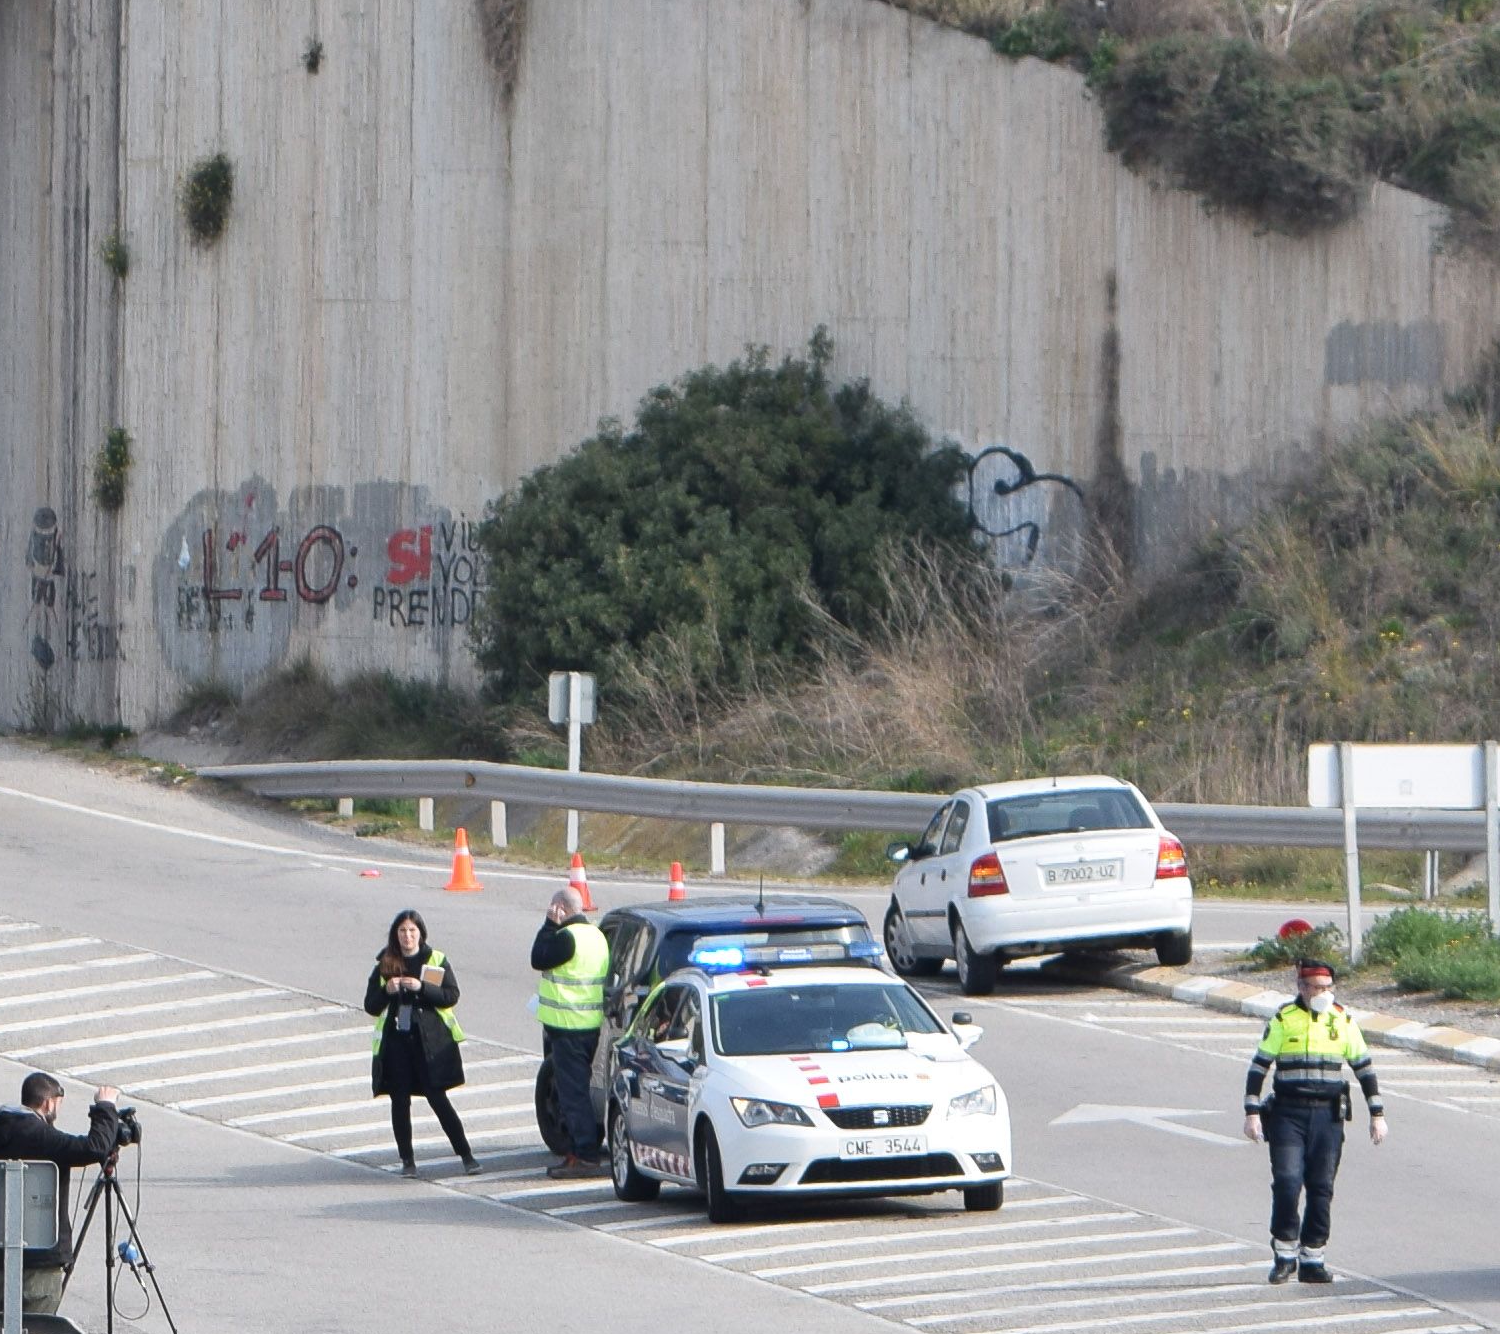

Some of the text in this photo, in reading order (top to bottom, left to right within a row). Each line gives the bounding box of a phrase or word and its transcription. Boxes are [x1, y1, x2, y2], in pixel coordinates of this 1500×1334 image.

[838, 1072, 909, 1083] policia
[845, 1138, 922, 1156] CME 3544
